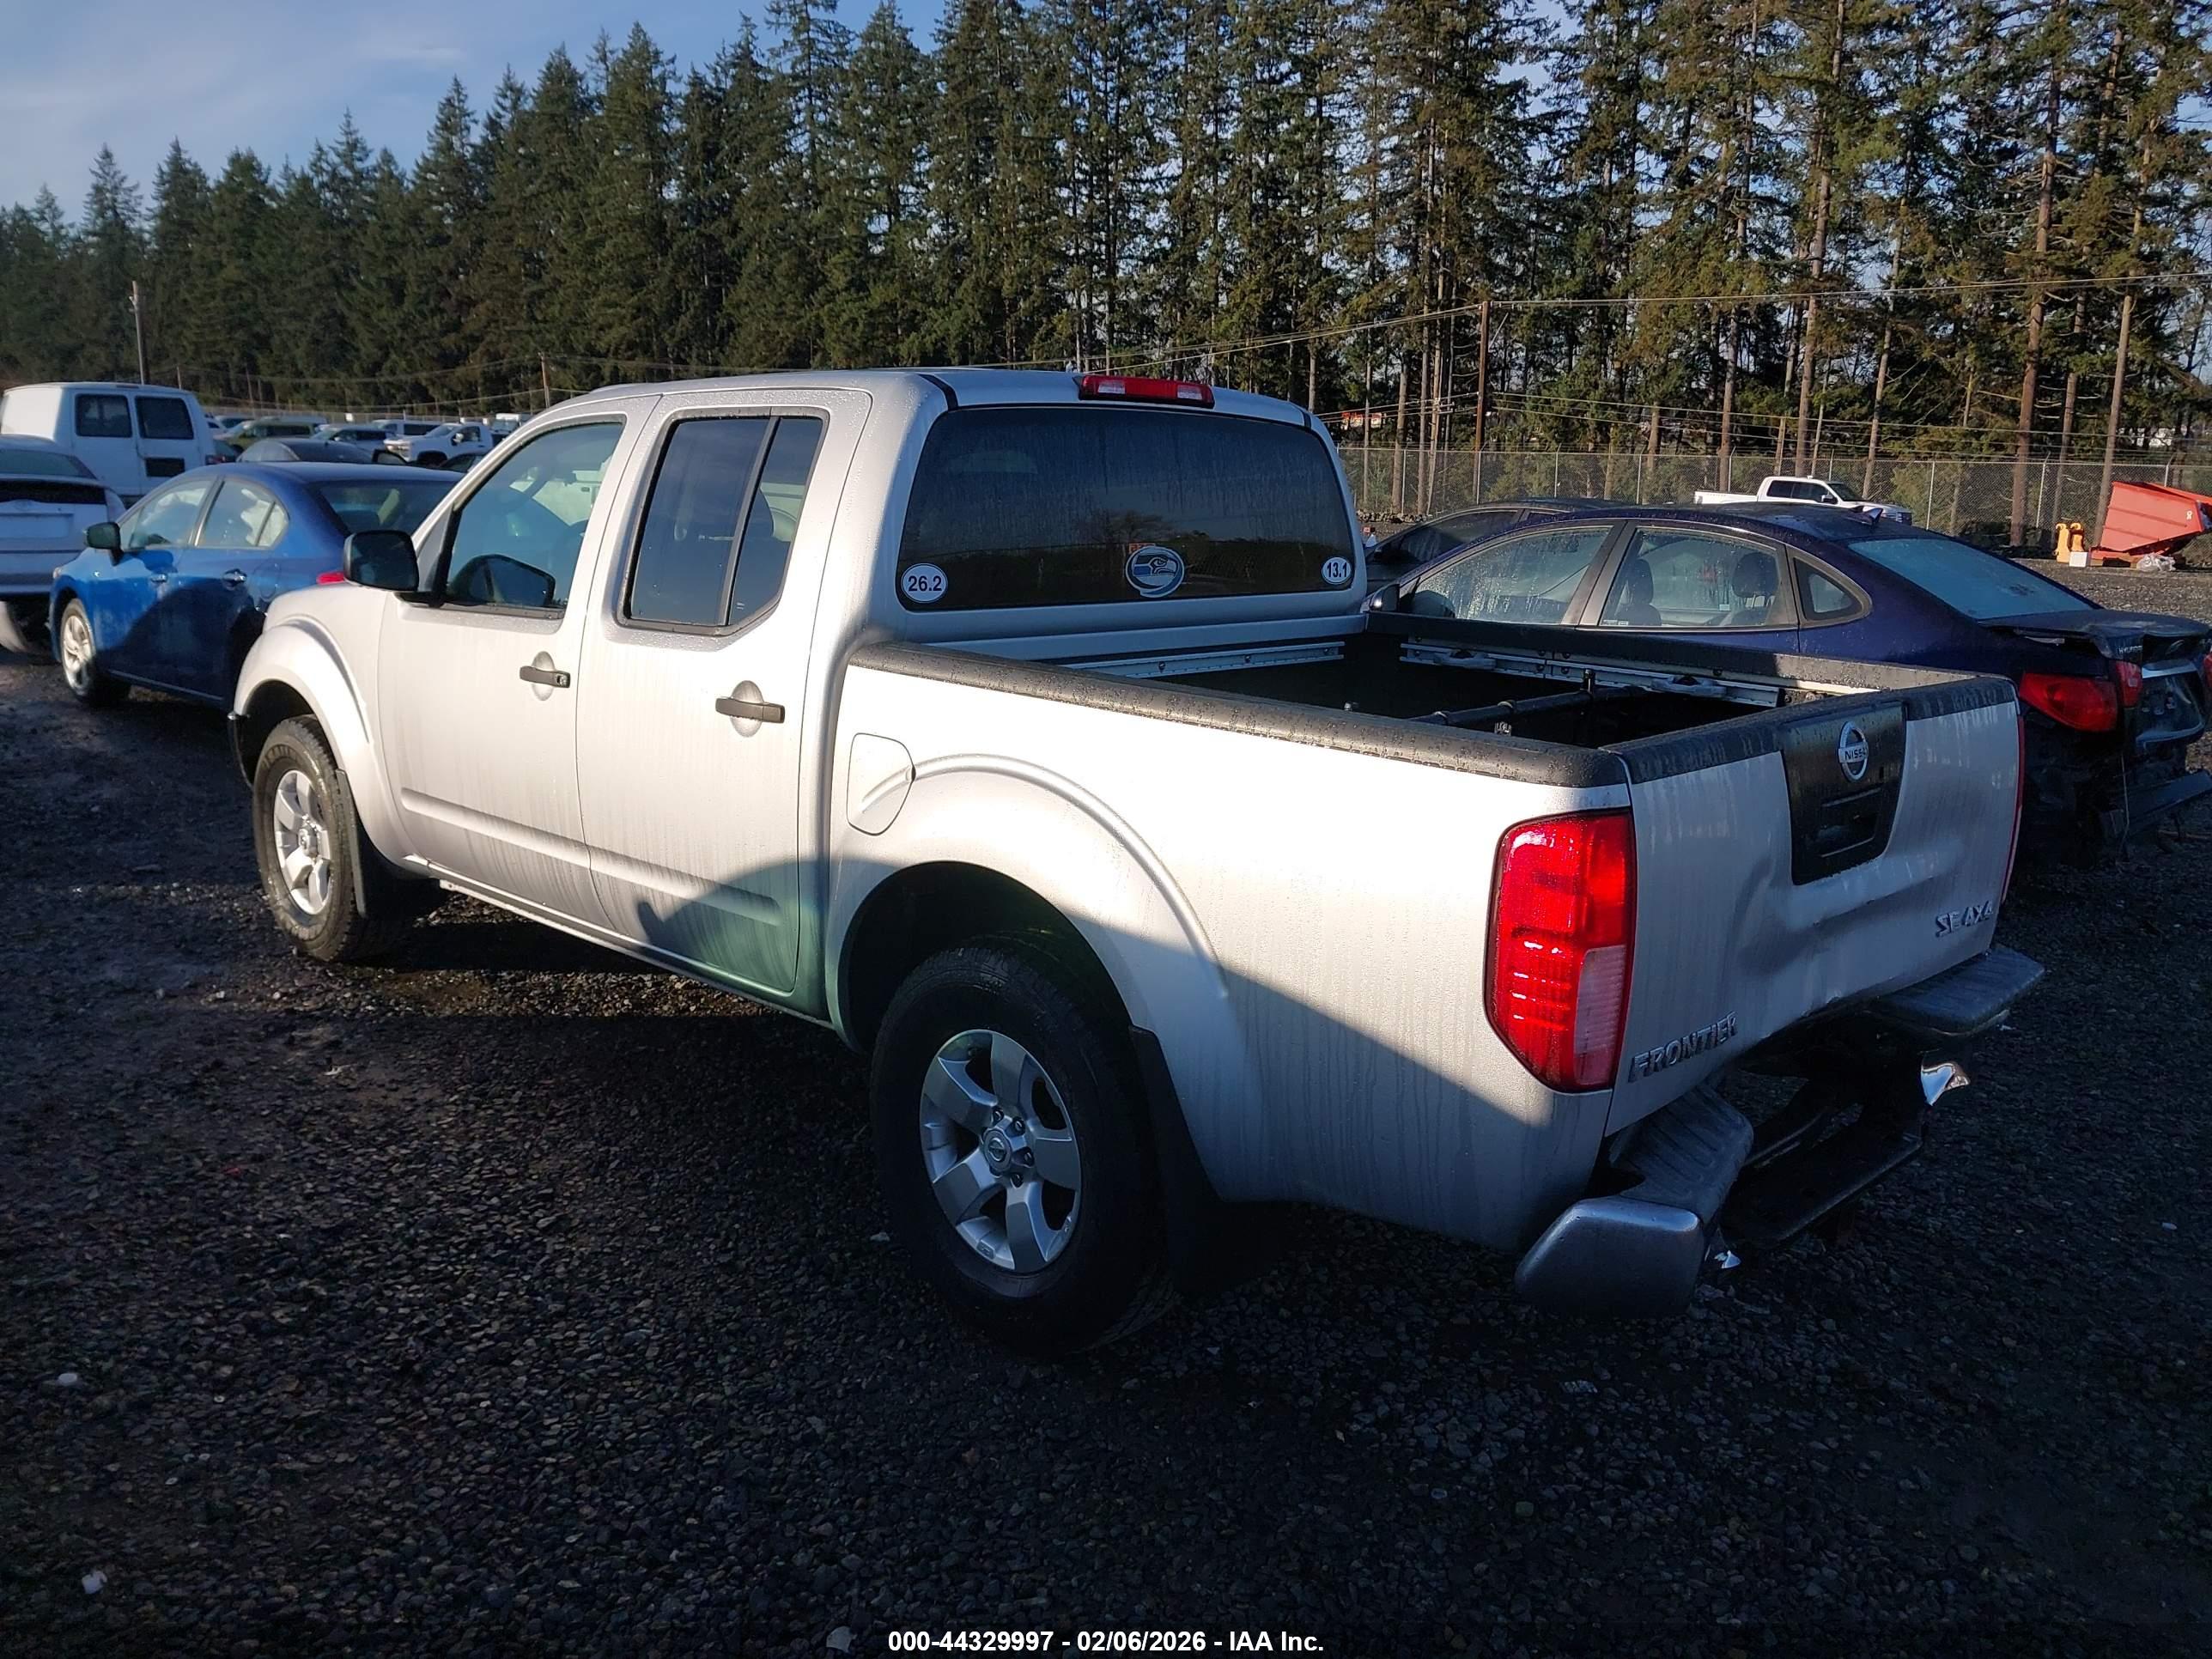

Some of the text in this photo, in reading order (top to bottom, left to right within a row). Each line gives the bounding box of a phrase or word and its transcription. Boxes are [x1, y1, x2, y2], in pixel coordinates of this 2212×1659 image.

[1327, 562, 1347, 578] 13.1
[908, 575, 942, 592] 26.2
[1844, 746, 1868, 761] NISS
[1936, 912, 1960, 938] SE
[1628, 1011, 1737, 1083] FRONTIER
